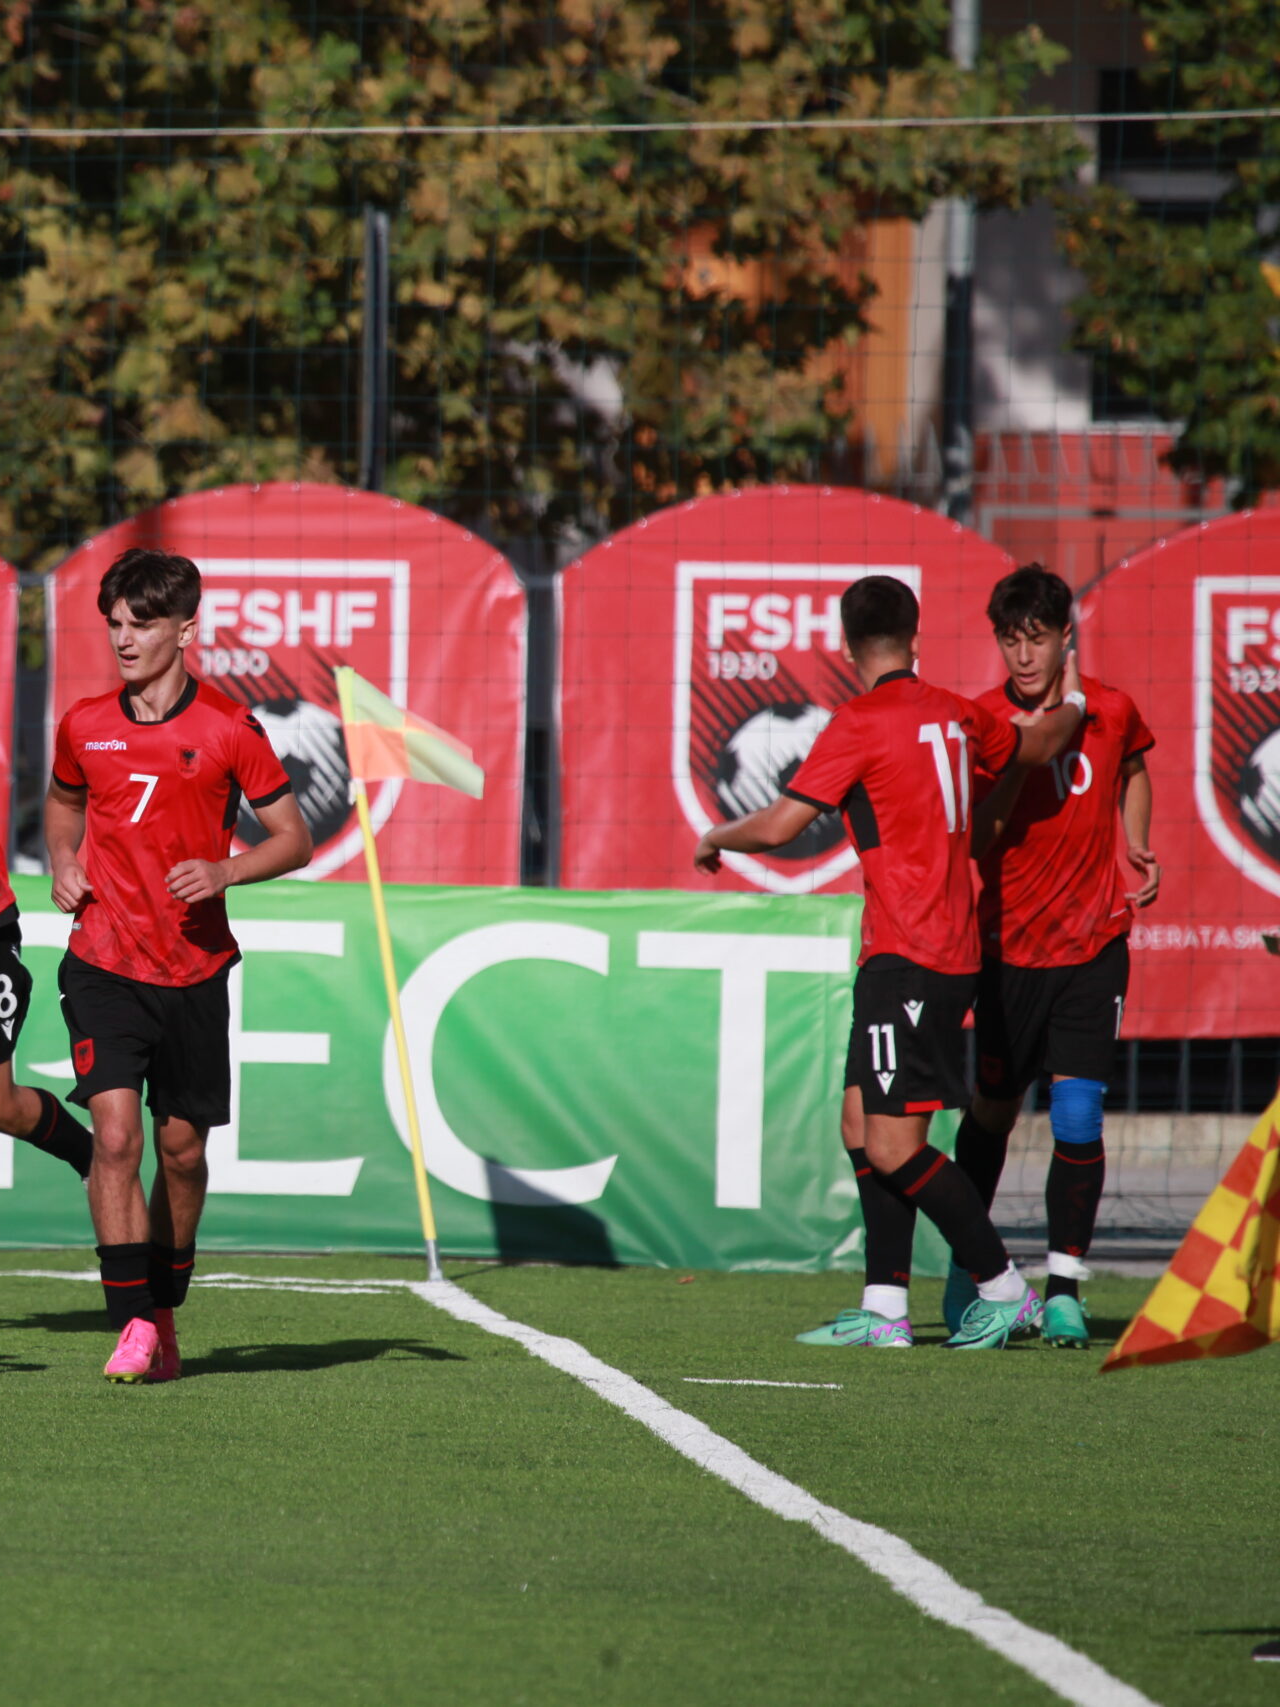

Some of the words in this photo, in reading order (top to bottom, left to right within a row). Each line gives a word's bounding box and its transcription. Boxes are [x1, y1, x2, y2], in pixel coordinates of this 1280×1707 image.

[199, 588, 377, 648] FSHF
[707, 593, 843, 652] FSH
[1227, 606, 1280, 665] F
[200, 648, 270, 677] 1930
[707, 650, 778, 681] 1930
[1229, 664, 1280, 694] 193
[129, 773, 160, 823] 7
[918, 720, 970, 834] 11
[1047, 750, 1093, 801] 10
[867, 1023, 897, 1072] 11
